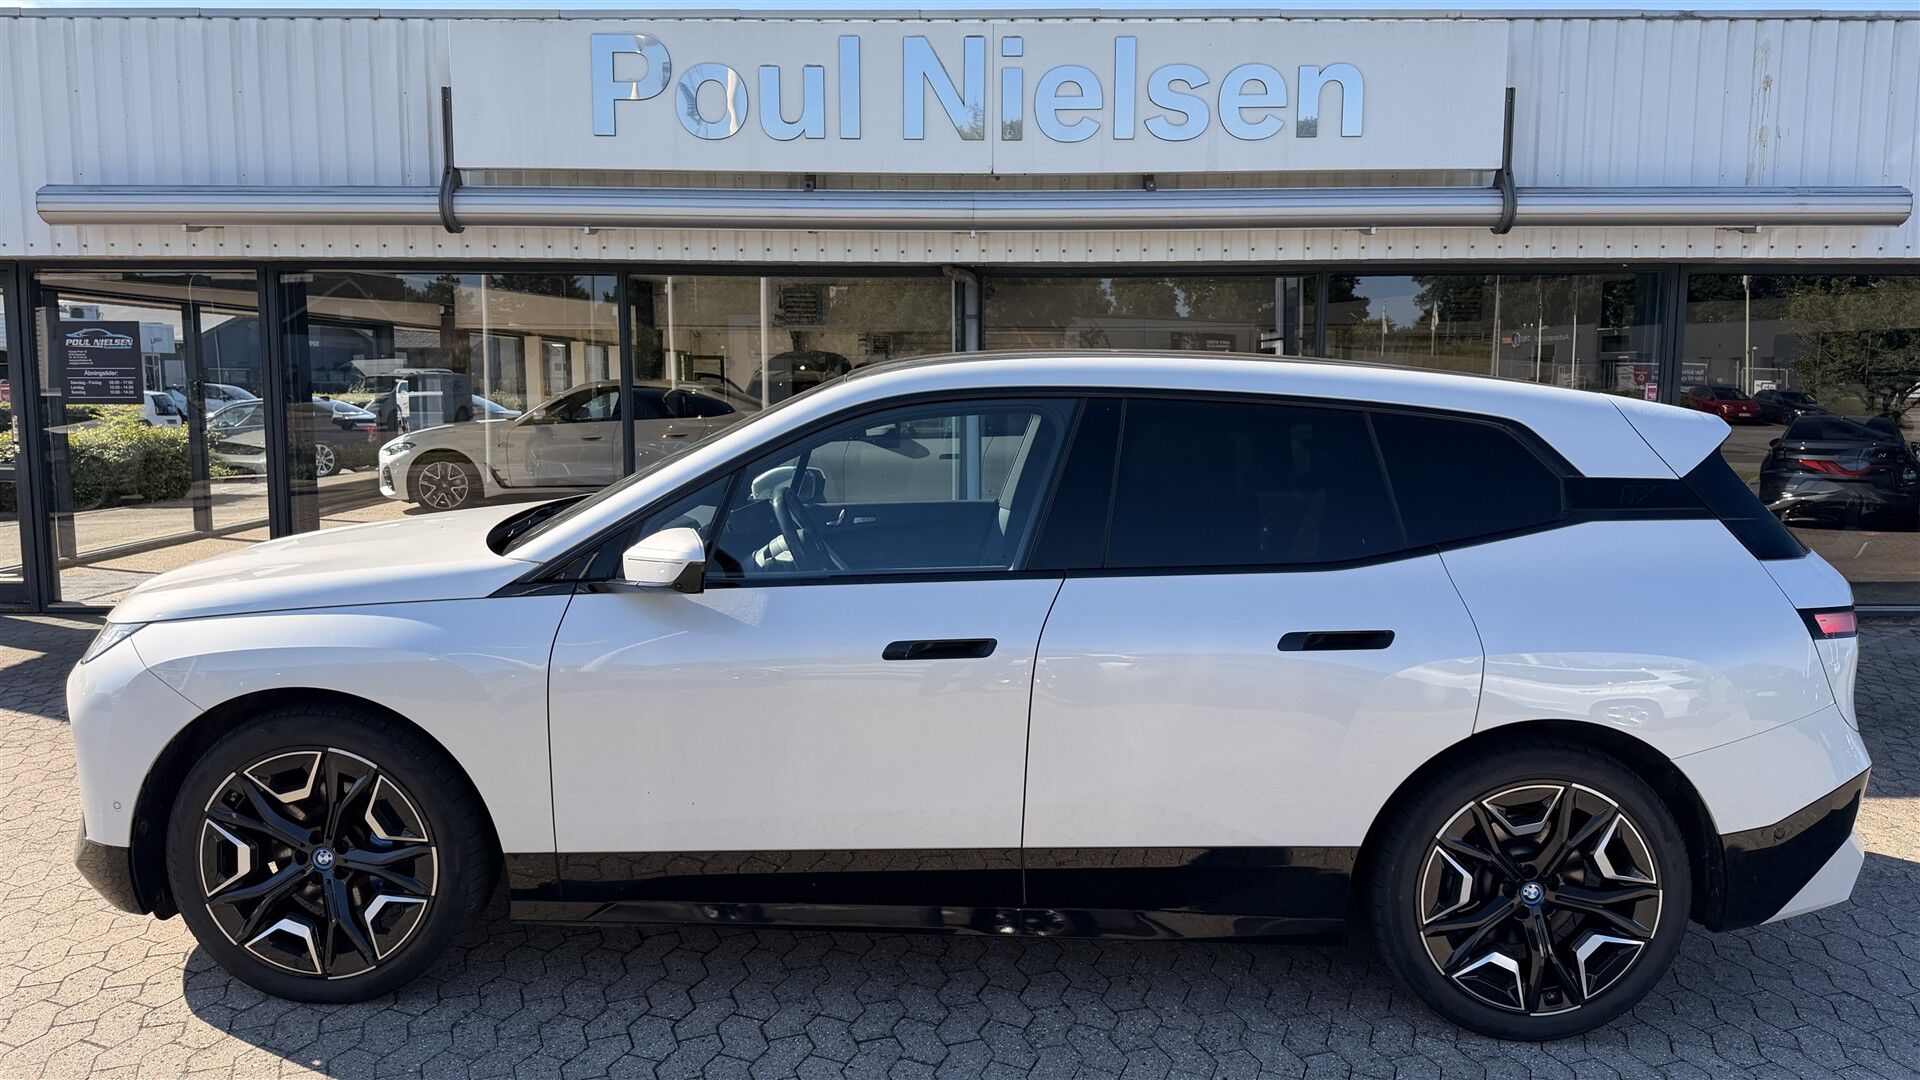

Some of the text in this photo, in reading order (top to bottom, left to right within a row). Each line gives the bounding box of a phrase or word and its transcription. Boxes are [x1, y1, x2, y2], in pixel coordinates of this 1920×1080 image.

[590, 33, 1365, 143] Poul Nielsen
[65, 338, 133, 346] POUL NIELSEN
